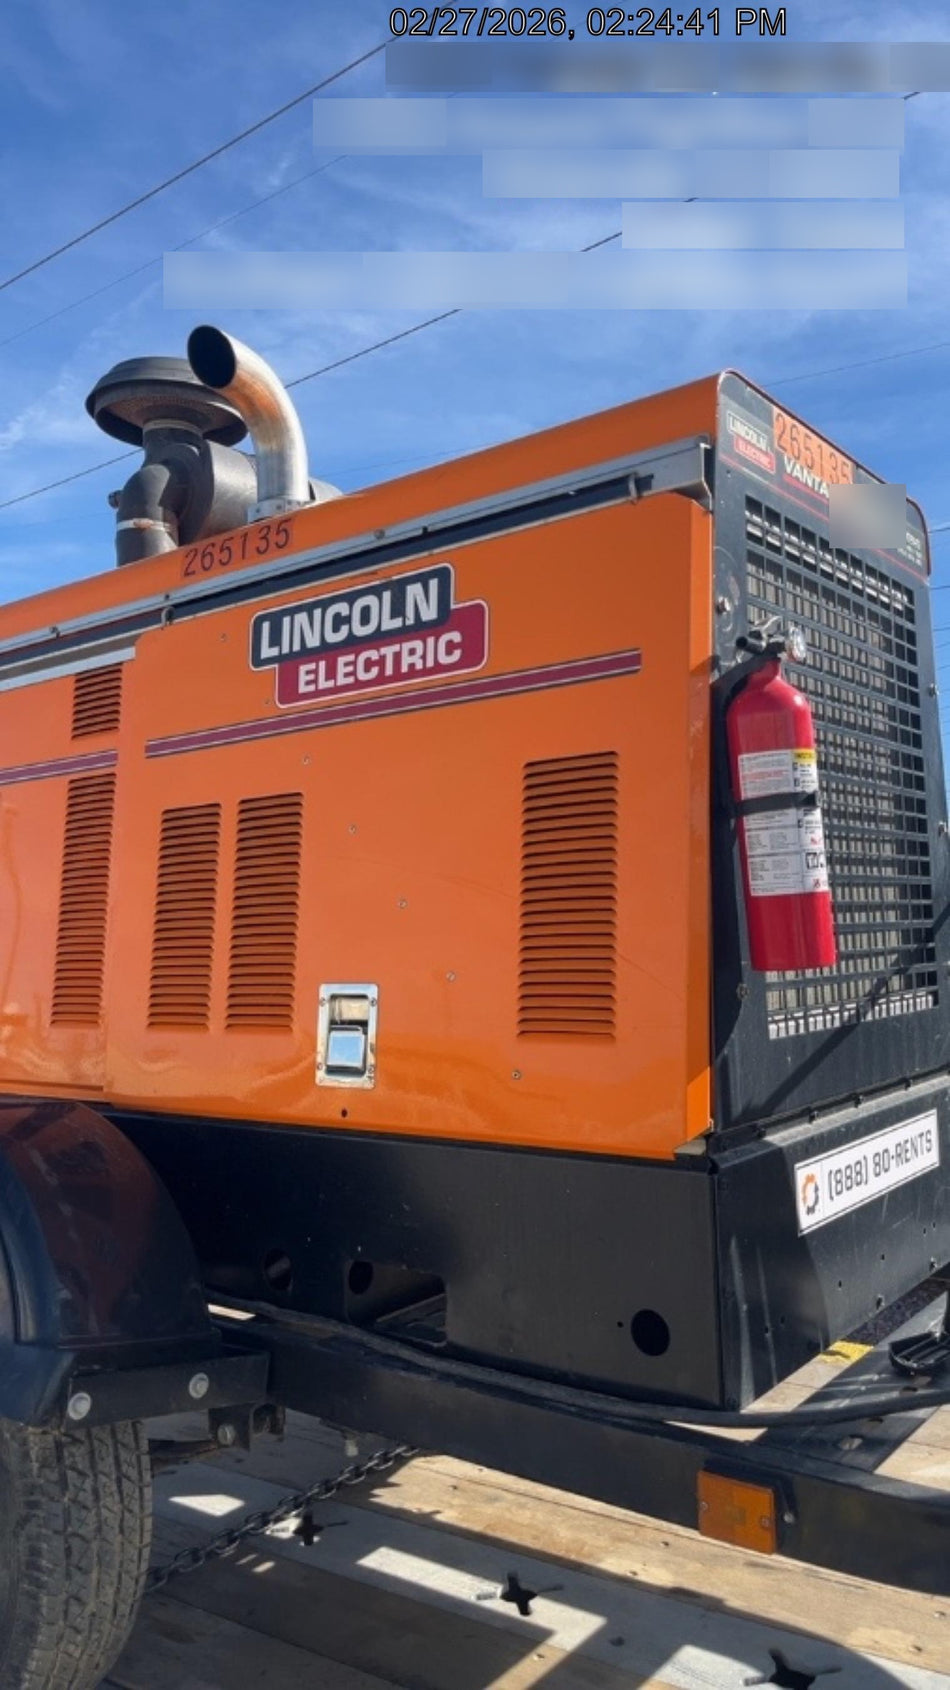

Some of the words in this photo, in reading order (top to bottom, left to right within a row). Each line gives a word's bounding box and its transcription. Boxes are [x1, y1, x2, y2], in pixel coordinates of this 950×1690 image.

[728, 414, 768, 452] LINCOLN
[783, 455, 829, 498] VANTA
[183, 518, 292, 578] 265135
[260, 578, 439, 660] LINCOLN
[298, 630, 463, 695] ELECTRIC
[827, 1155, 869, 1201] (888)
[872, 1129, 932, 1177] 80-RENTS
